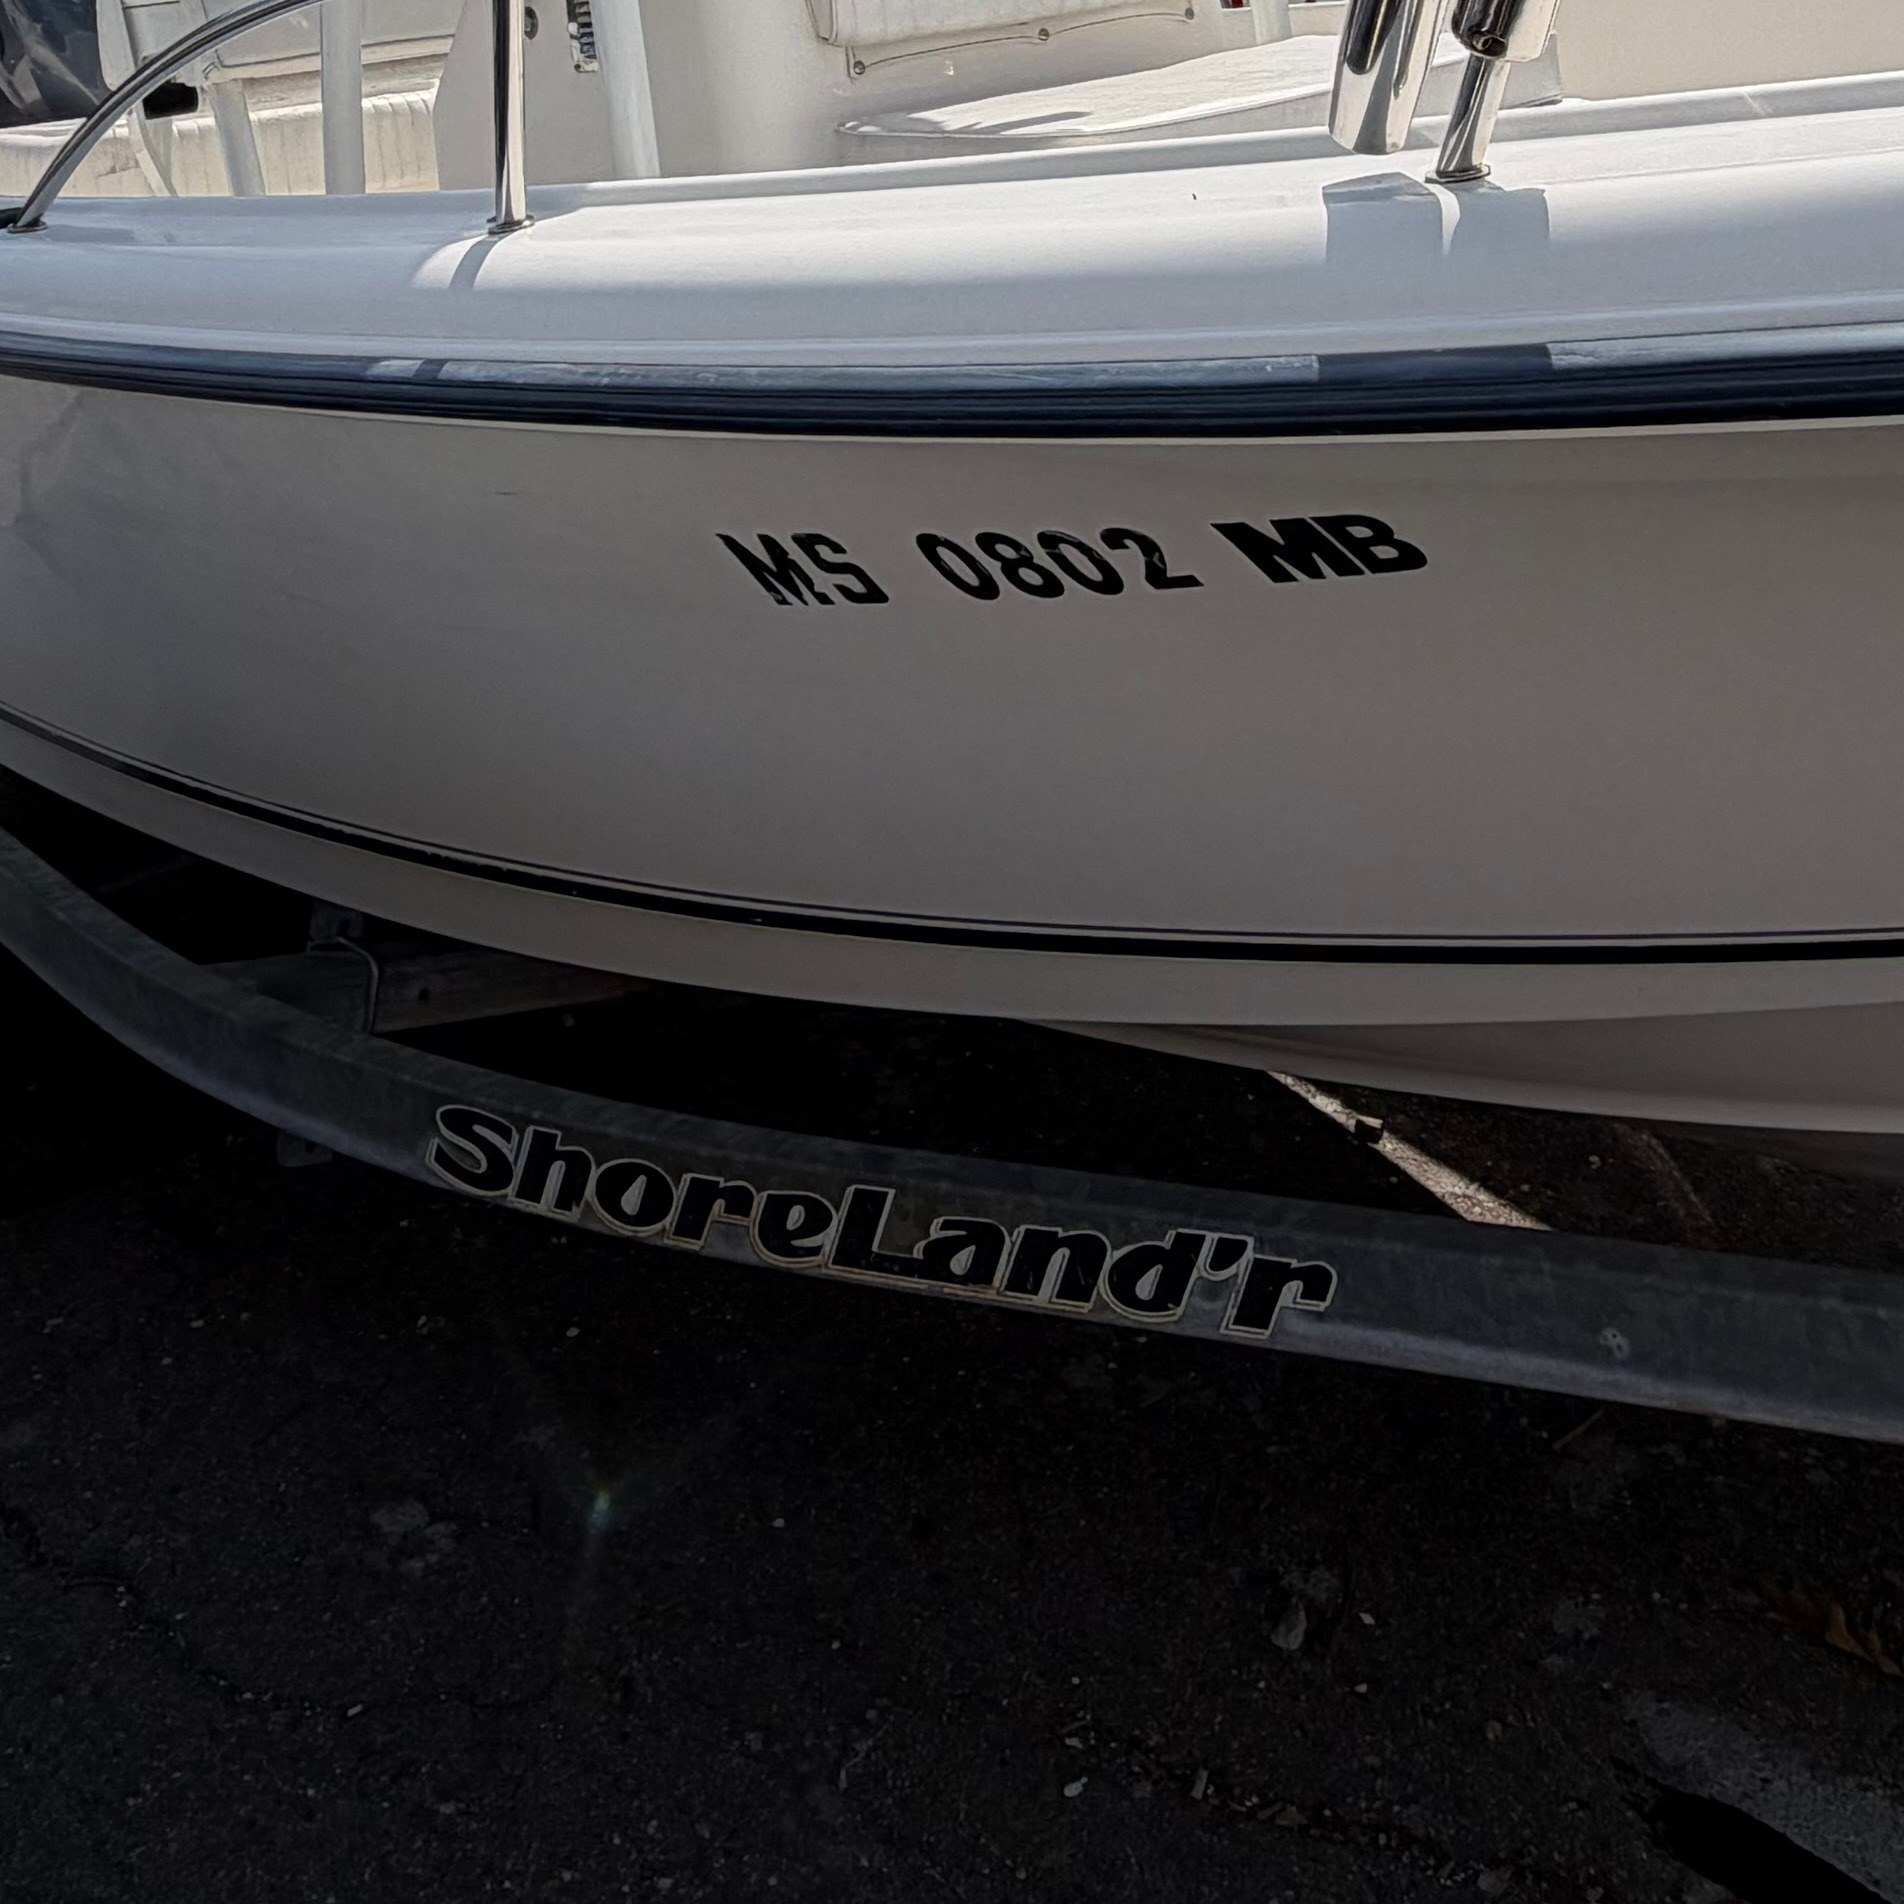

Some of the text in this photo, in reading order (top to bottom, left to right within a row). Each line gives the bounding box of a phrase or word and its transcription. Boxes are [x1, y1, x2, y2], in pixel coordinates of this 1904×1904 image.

[714, 513, 1429, 606] MS 0802 MB
[425, 1103, 1339, 1339] ShoreLand'r
